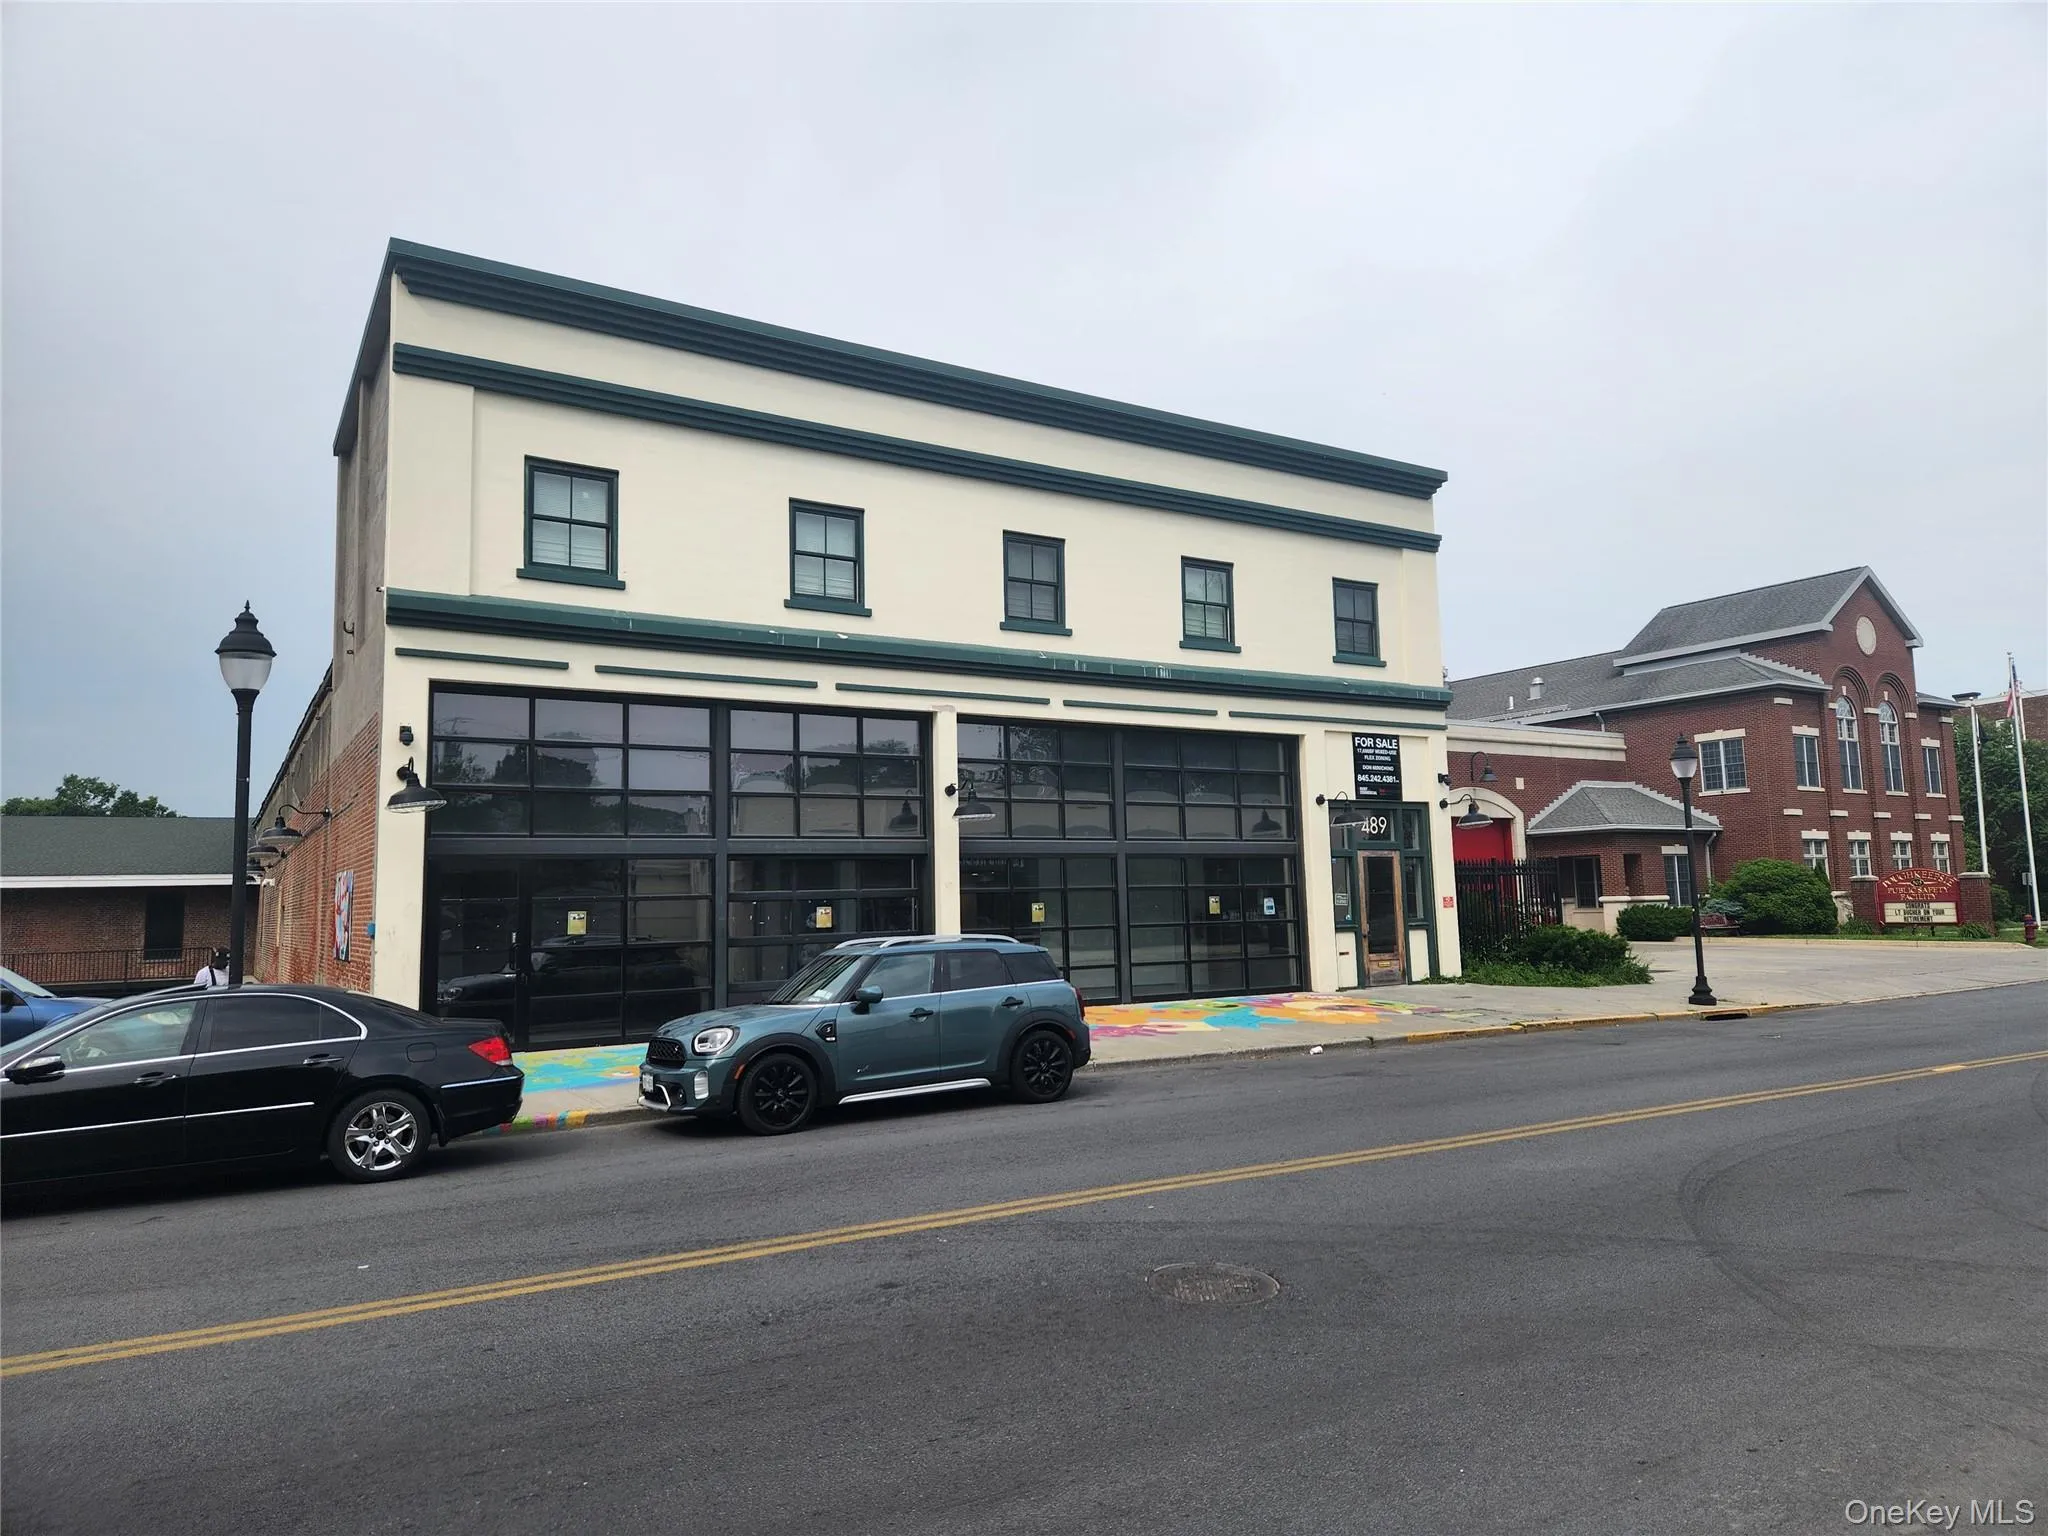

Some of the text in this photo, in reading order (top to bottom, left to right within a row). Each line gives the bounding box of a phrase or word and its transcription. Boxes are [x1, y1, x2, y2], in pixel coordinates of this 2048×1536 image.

[1354, 736, 1398, 749] FOR SALE
[1361, 816, 1387, 834] 489
[1882, 871, 1959, 888] POUGHKEEPSIE
